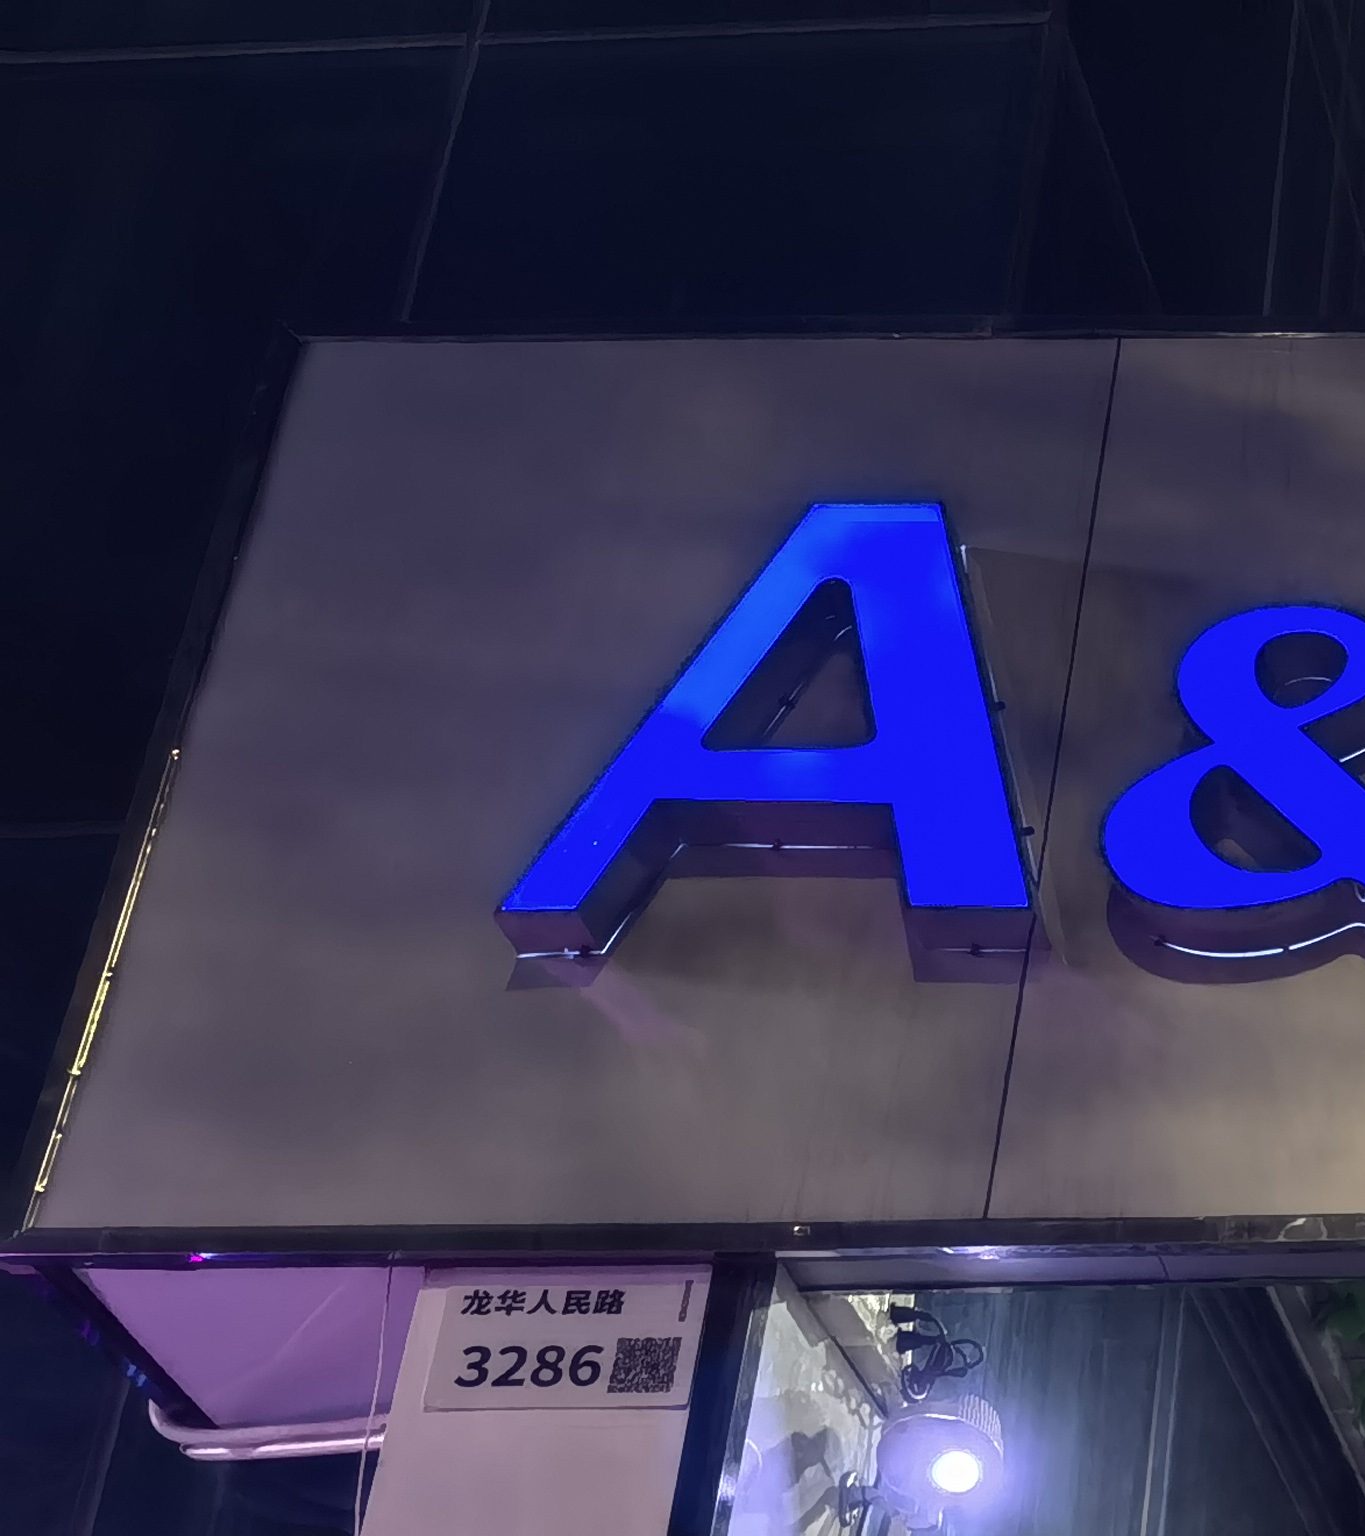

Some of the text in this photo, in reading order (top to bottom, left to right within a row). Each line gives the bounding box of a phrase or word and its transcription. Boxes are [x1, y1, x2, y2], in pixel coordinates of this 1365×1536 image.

[461, 1289, 626, 1316] 龙华人民路
[454, 1345, 604, 1387] 3286
